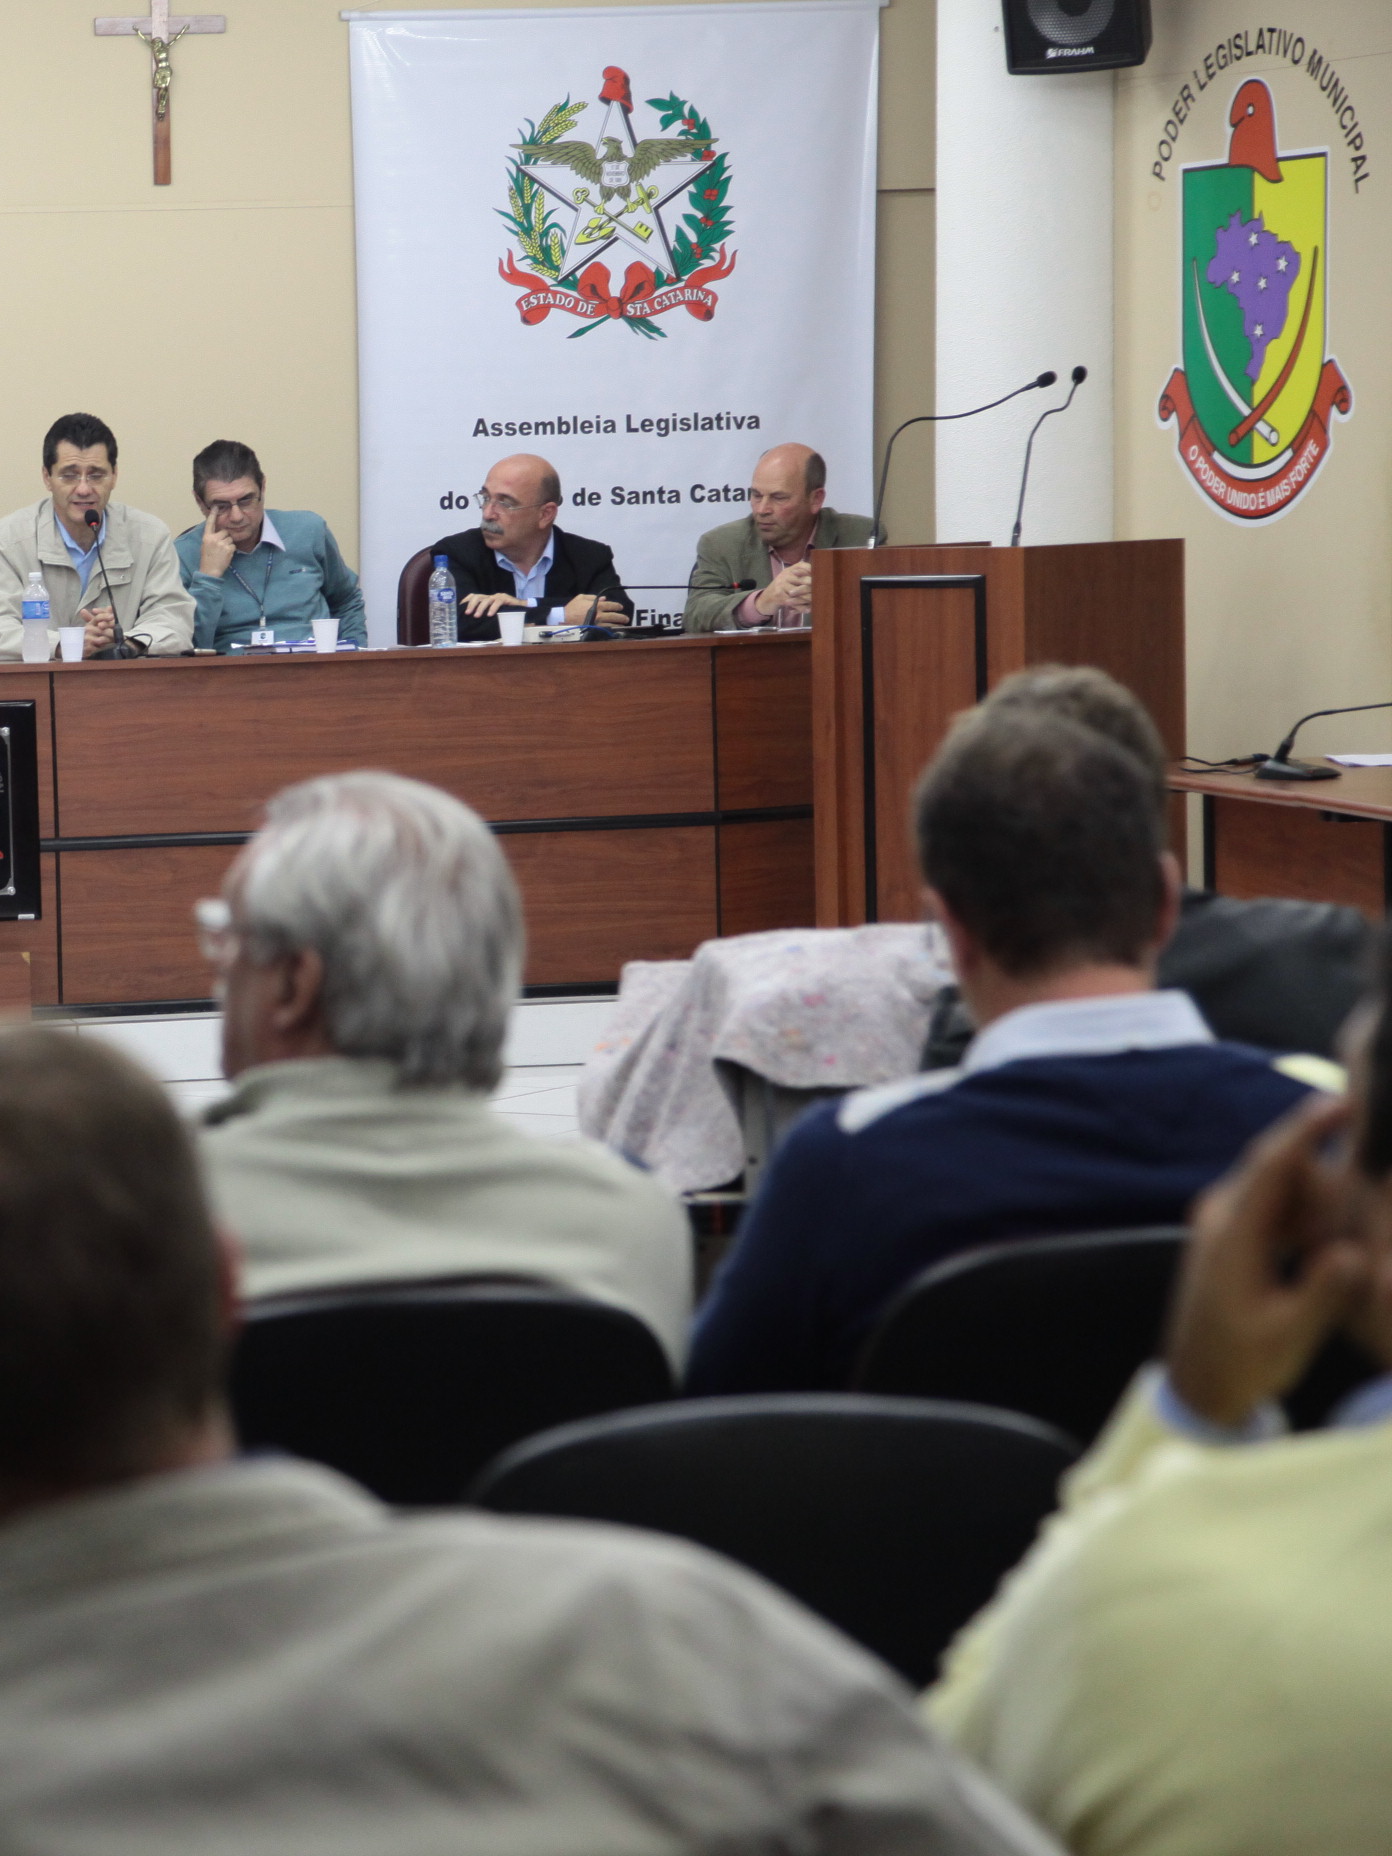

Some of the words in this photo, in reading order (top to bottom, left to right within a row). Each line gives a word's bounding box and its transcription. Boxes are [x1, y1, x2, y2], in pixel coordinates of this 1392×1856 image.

[1057, 46, 1095, 57] FRAHM
[1152, 83, 1196, 181] PODER
[1192, 27, 1305, 92] LEGISLATIVO
[1306, 48, 1370, 194] MUNICIPAL
[521, 293, 575, 311] ESTADO
[576, 302, 597, 316] DE
[654, 288, 714, 309] CATARINA
[472, 415, 617, 437] Assembleia
[625, 411, 761, 437] Legislativa
[1189, 445, 1199, 461] O
[1195, 456, 1227, 499] PODER
[1227, 487, 1257, 510] UNIDO
[1265, 479, 1292, 507] MAIS
[1288, 439, 1320, 489] FORTE
[439, 491, 470, 510] do
[571, 487, 602, 507] de
[610, 485, 682, 506] Santa
